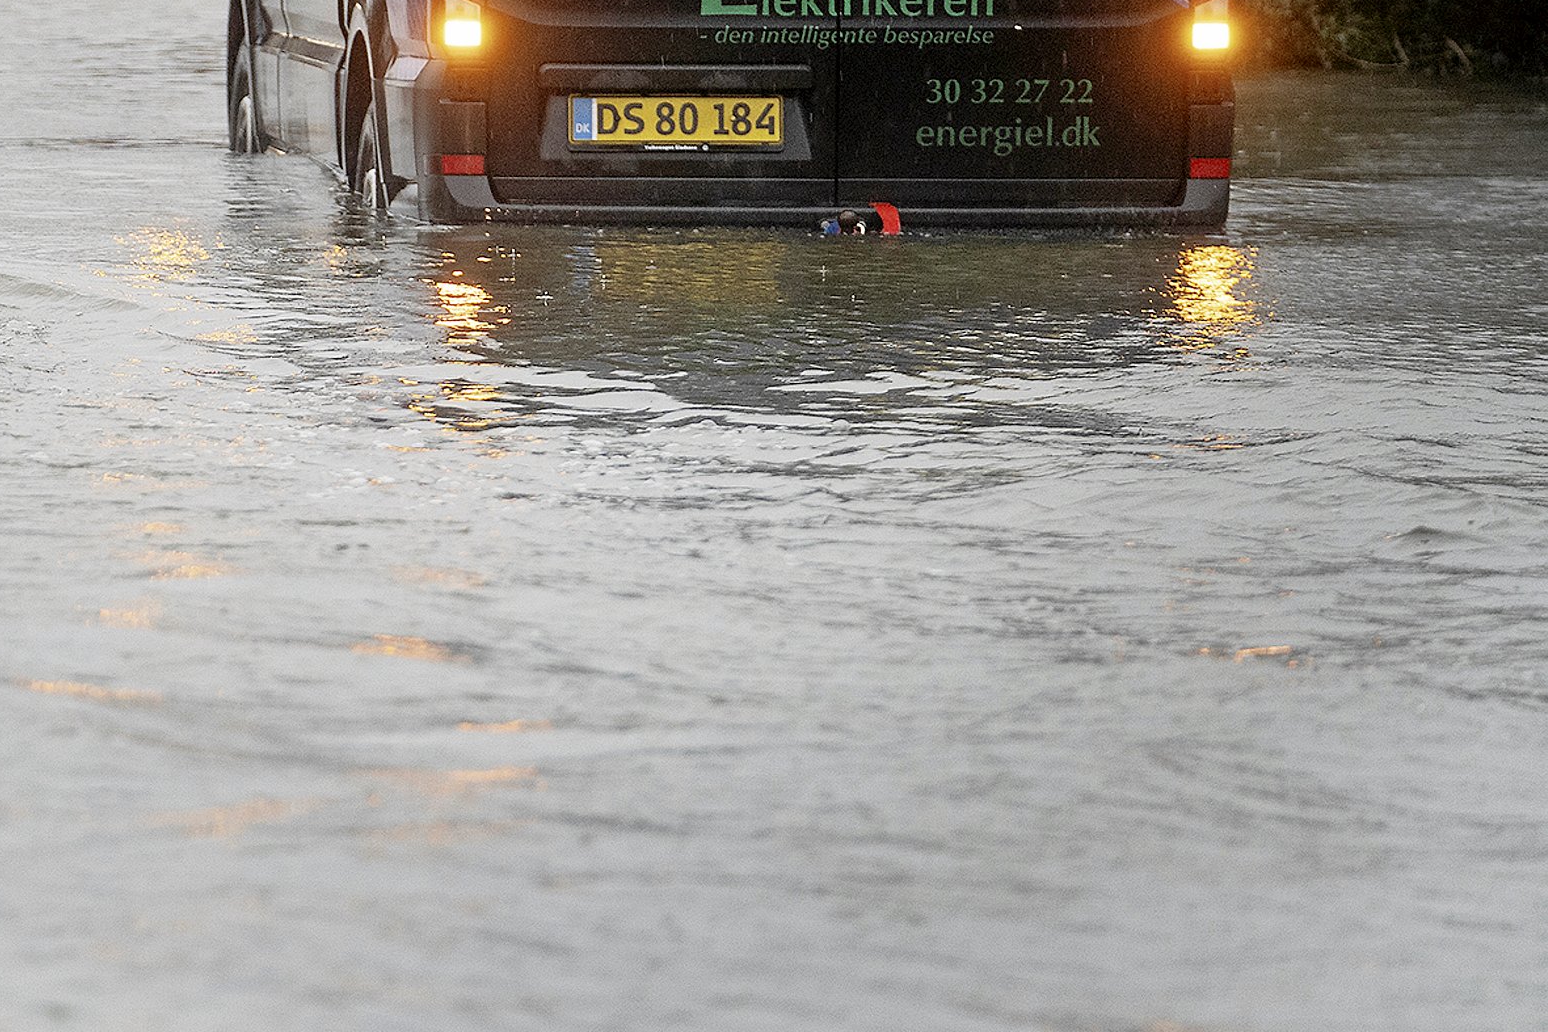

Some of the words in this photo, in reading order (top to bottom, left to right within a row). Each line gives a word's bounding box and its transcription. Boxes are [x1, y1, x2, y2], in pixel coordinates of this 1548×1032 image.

[714, 25, 753, 44] den
[760, 25, 878, 49] intelligente
[884, 25, 995, 49] besparelse
[926, 79, 960, 104] 30
[971, 79, 1004, 104] 32
[1015, 79, 1050, 104] 27
[1060, 79, 1093, 104] 22
[575, 122, 591, 134] DK
[597, 102, 645, 135] DS
[655, 102, 699, 135] 80
[713, 102, 776, 135] 184
[916, 116, 1101, 156] energiel.dk
